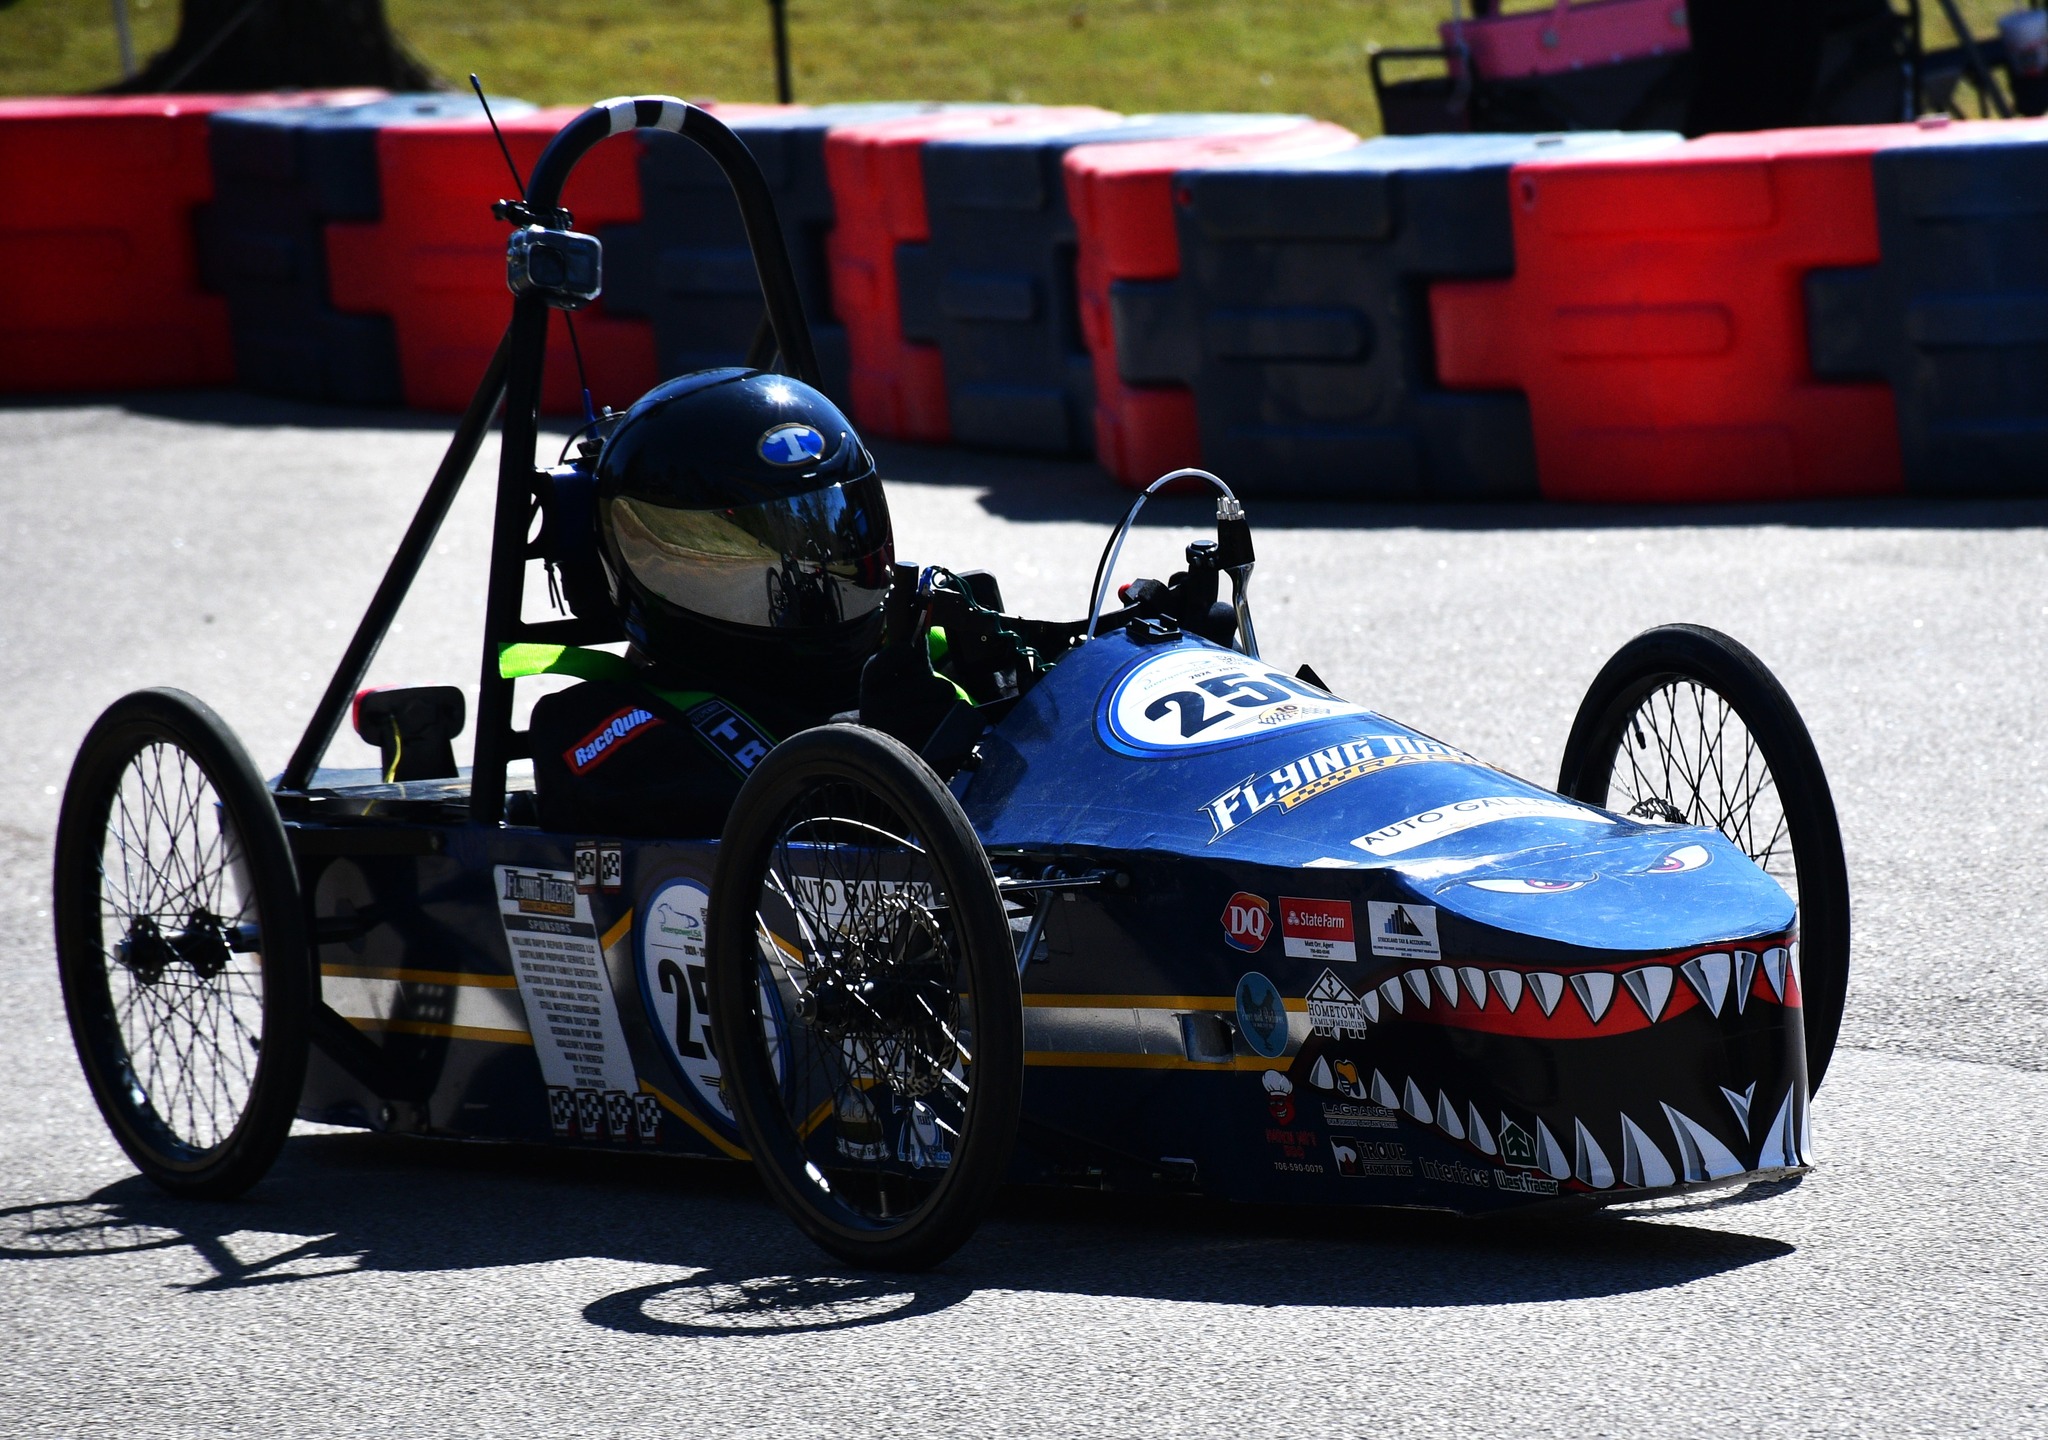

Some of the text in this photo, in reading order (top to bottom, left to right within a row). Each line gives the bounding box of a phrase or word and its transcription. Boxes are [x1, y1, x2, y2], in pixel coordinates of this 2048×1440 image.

[766, 428, 810, 462] T
[574, 708, 654, 767] RaceQuip
[1209, 739, 1374, 837] FLYING
[1363, 811, 1444, 846] AUTO
[795, 879, 837, 906] AUTO
[528, 919, 572, 934] SPONSORS
[1230, 905, 1265, 940] DQ
[585, 944, 595, 953] LLC
[586, 957, 595, 966] LLC
[1308, 1003, 1363, 1020] HOMETOWN
[1310, 1017, 1366, 1029] FAMILY MEDICINE
[1357, 1141, 1406, 1160] TROUP
[1273, 1161, 1324, 1174] 706-590-0079
[1419, 1156, 1489, 1188] Interface
